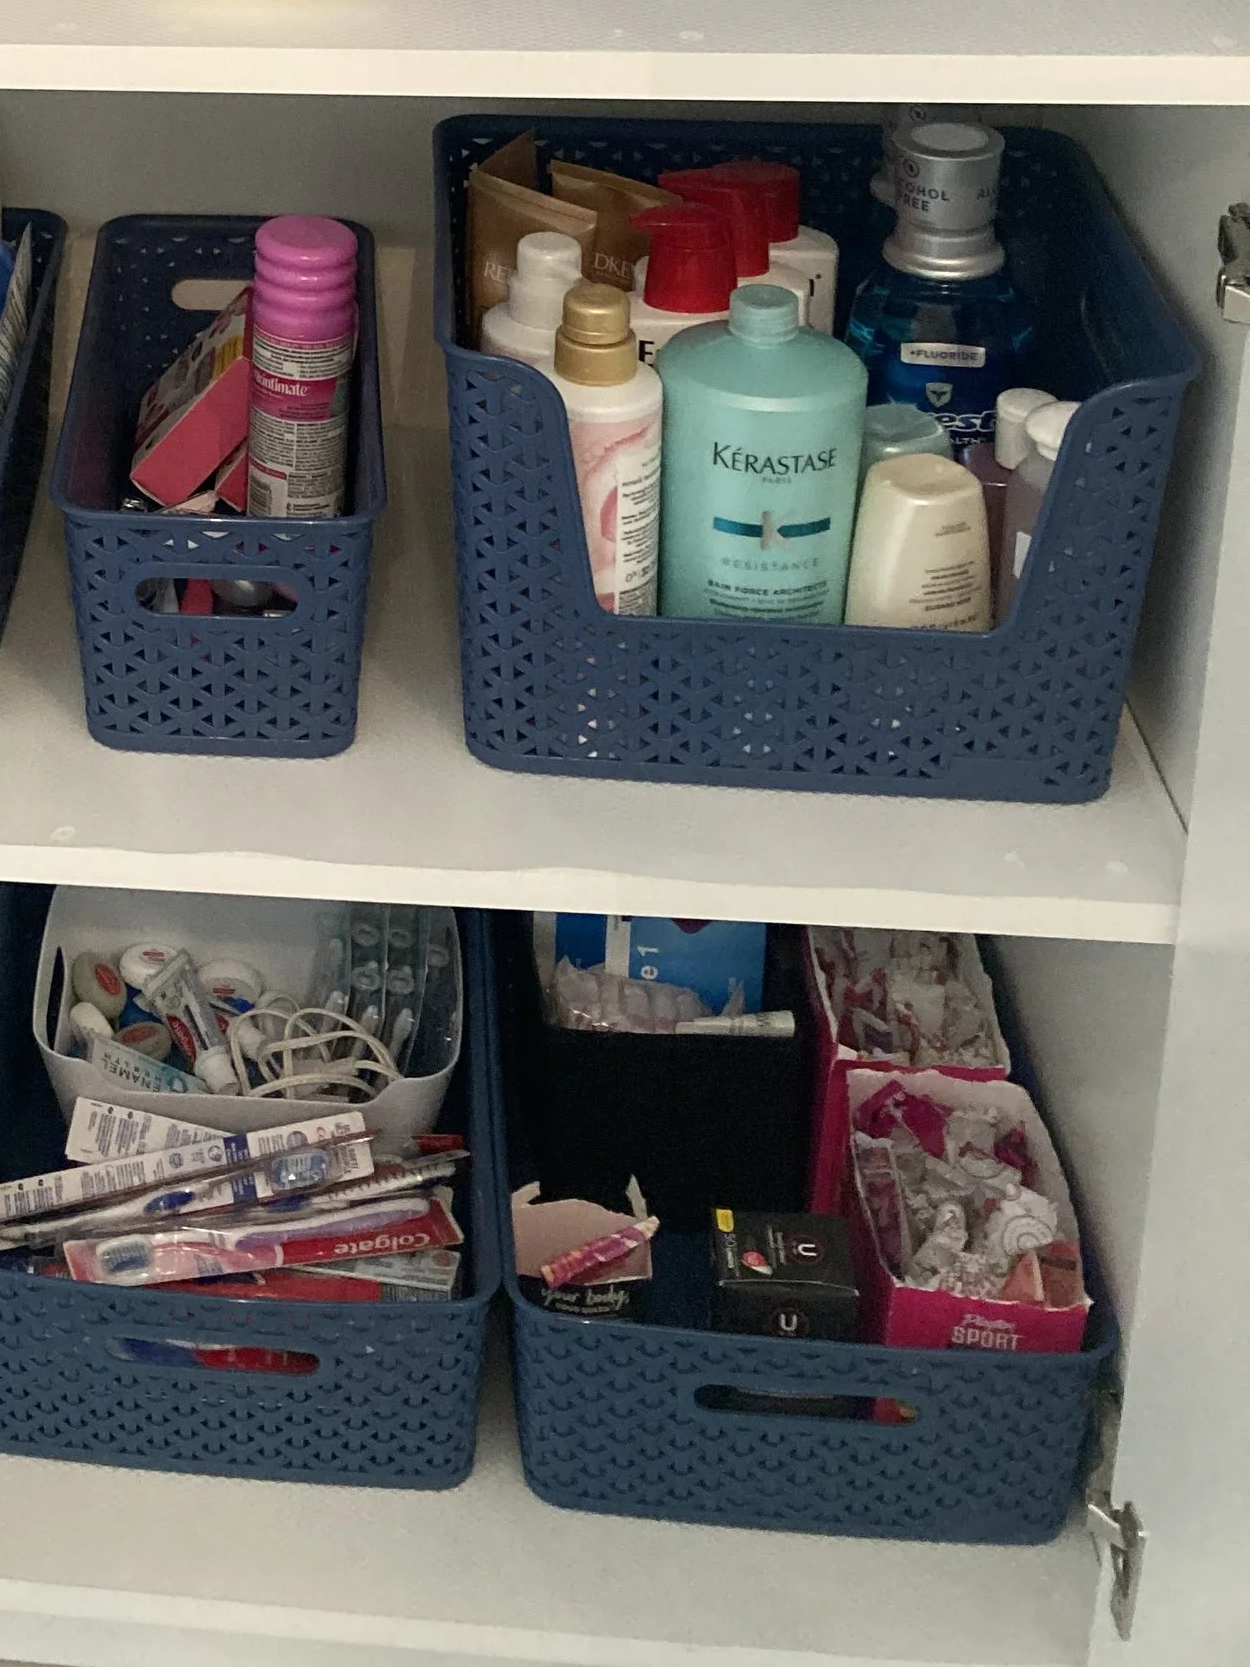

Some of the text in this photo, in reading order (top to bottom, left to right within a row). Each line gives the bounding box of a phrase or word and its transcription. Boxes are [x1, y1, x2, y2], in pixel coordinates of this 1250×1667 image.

[713, 441, 838, 476] KÉRASTASE
[334, 1233, 431, 1255] Colgate
[951, 1325, 1023, 1350] SPORT
